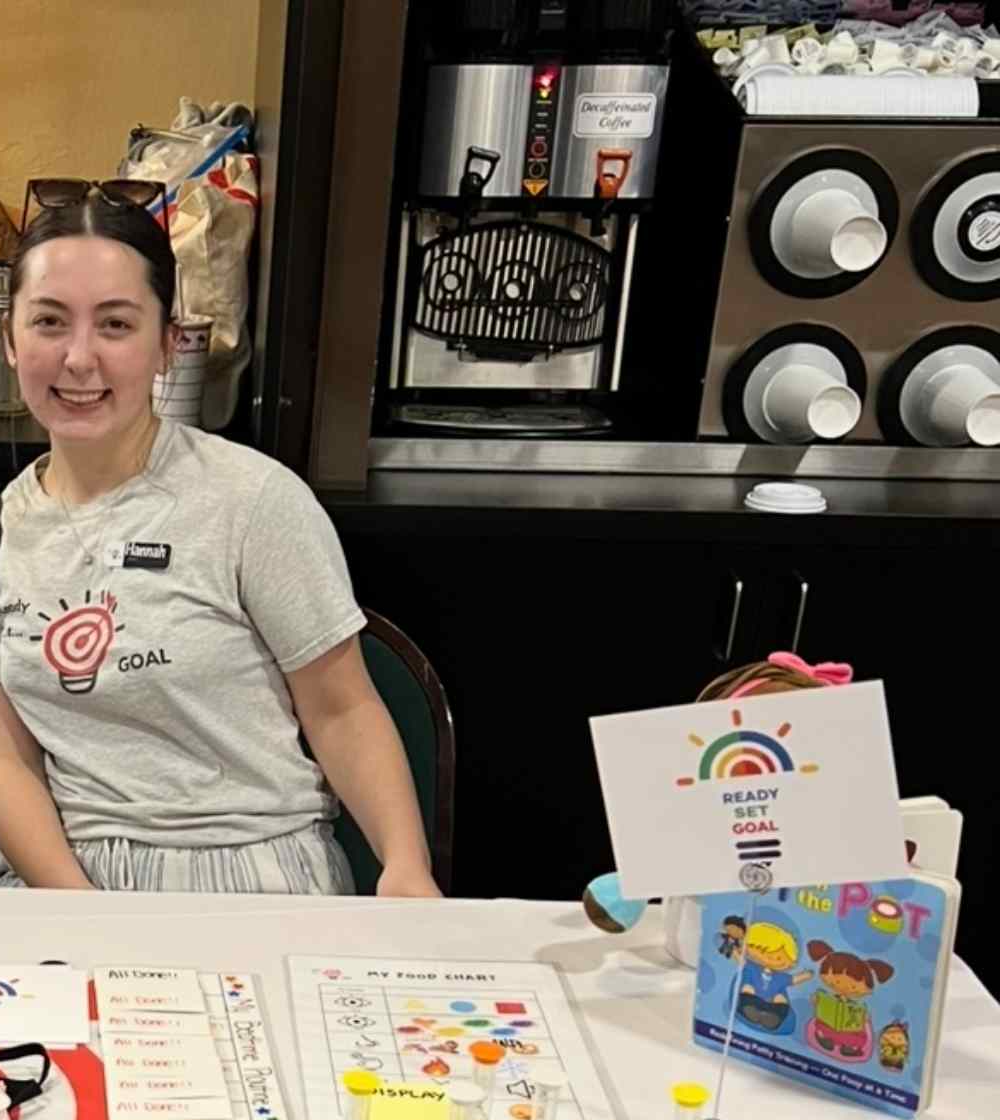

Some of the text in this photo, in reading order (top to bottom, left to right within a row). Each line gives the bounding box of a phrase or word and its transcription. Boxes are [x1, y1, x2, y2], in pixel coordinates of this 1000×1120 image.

[599, 116, 632, 131] Coffee
[124, 542, 167, 559] Hannah
[118, 648, 172, 672] GOAL
[722, 787, 779, 804] READY
[734, 804, 768, 818] SET
[732, 820, 779, 834] GOAL
[797, 882, 932, 940] the POT
[367, 970, 496, 982] MY FOOD CHART
